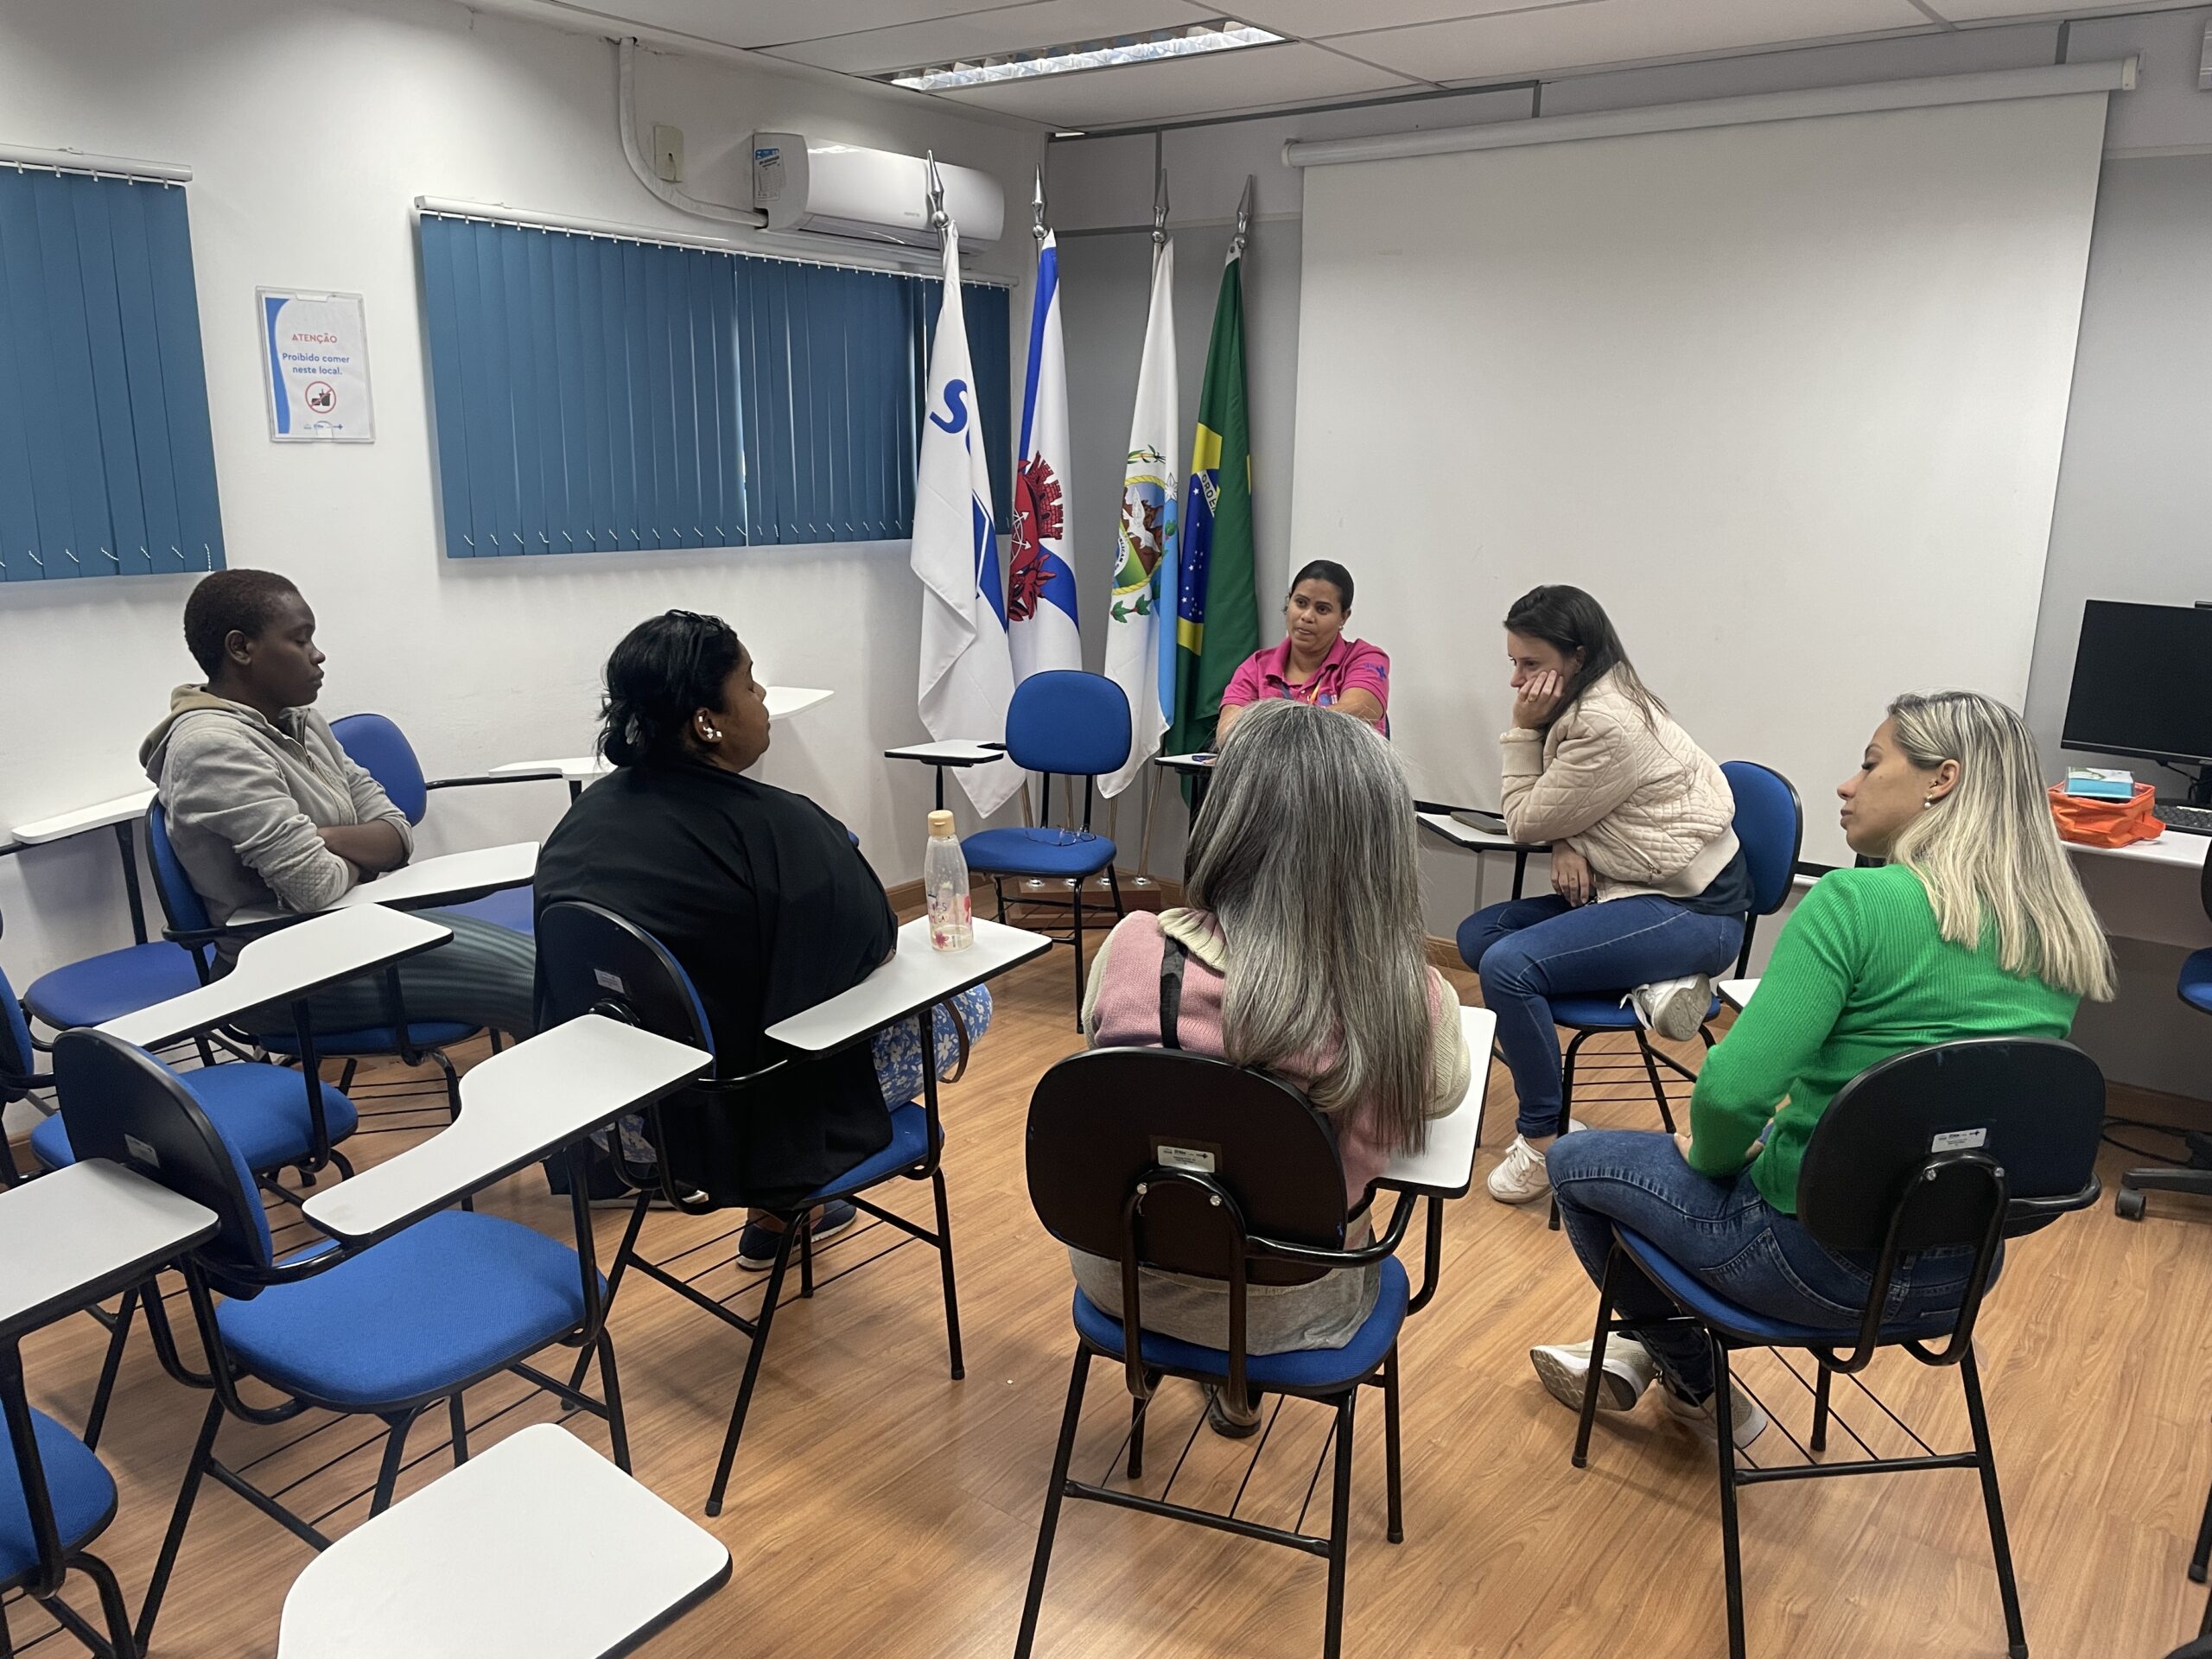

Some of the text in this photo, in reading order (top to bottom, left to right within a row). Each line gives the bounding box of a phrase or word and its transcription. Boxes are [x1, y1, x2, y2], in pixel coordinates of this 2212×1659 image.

[291, 333, 338, 344] ATENÇÃO
[282, 353, 320, 362] Proibido
[319, 365, 343, 375] local.
[1201, 474, 1217, 512] ORDE
